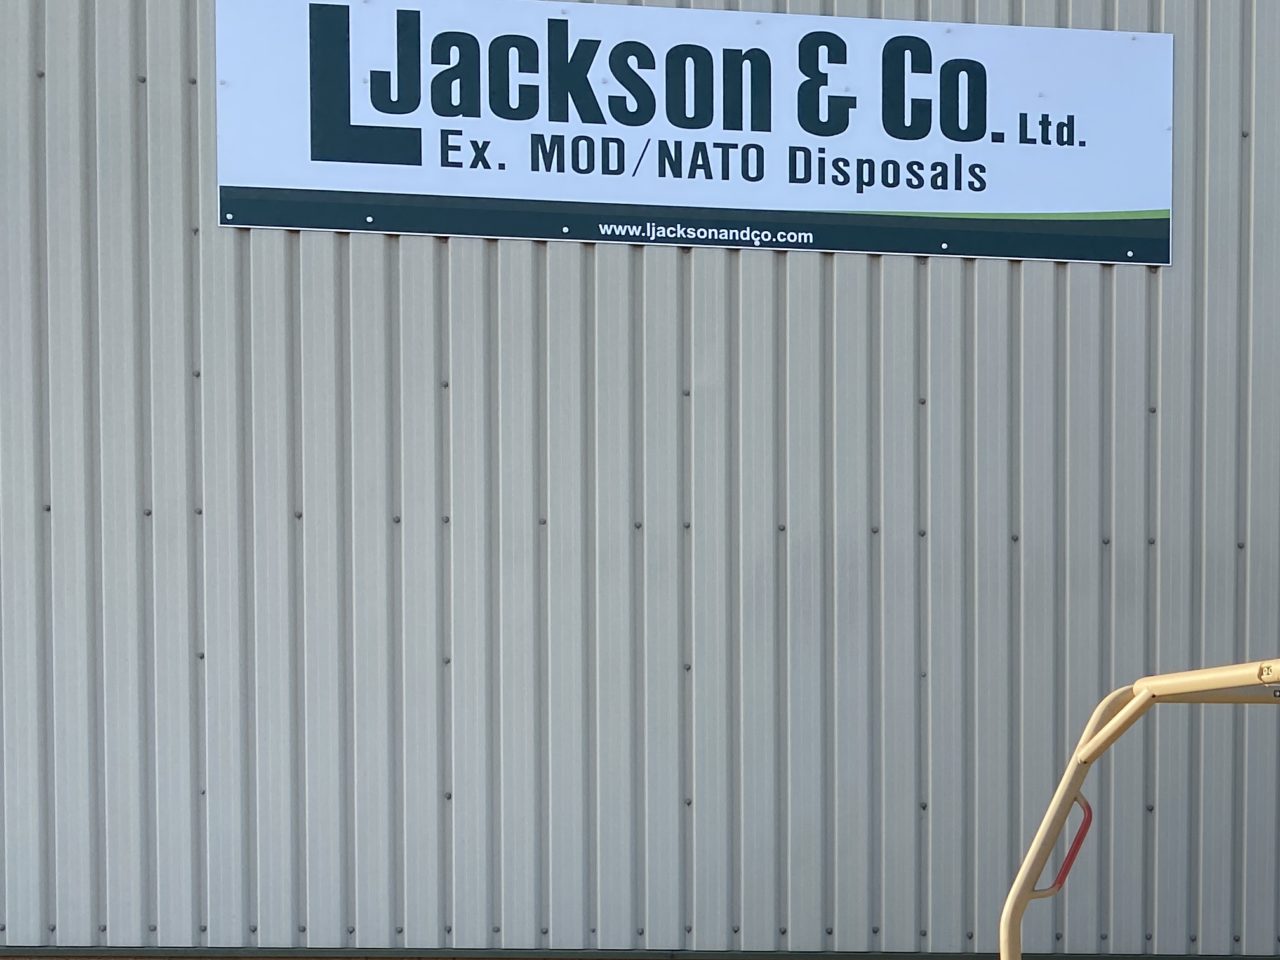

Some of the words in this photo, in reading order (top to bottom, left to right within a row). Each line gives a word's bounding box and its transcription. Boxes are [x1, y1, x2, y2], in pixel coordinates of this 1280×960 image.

[797, 31, 857, 137] &
[882, 35, 1005, 143] Co.
[1019, 113, 1086, 147] Ltd.
[440, 129, 506, 170] Ex.
[531, 133, 765, 182] MOD/NATO
[789, 147, 987, 193] Disposals
[599, 222, 813, 244] www.ljacksonandco.com
